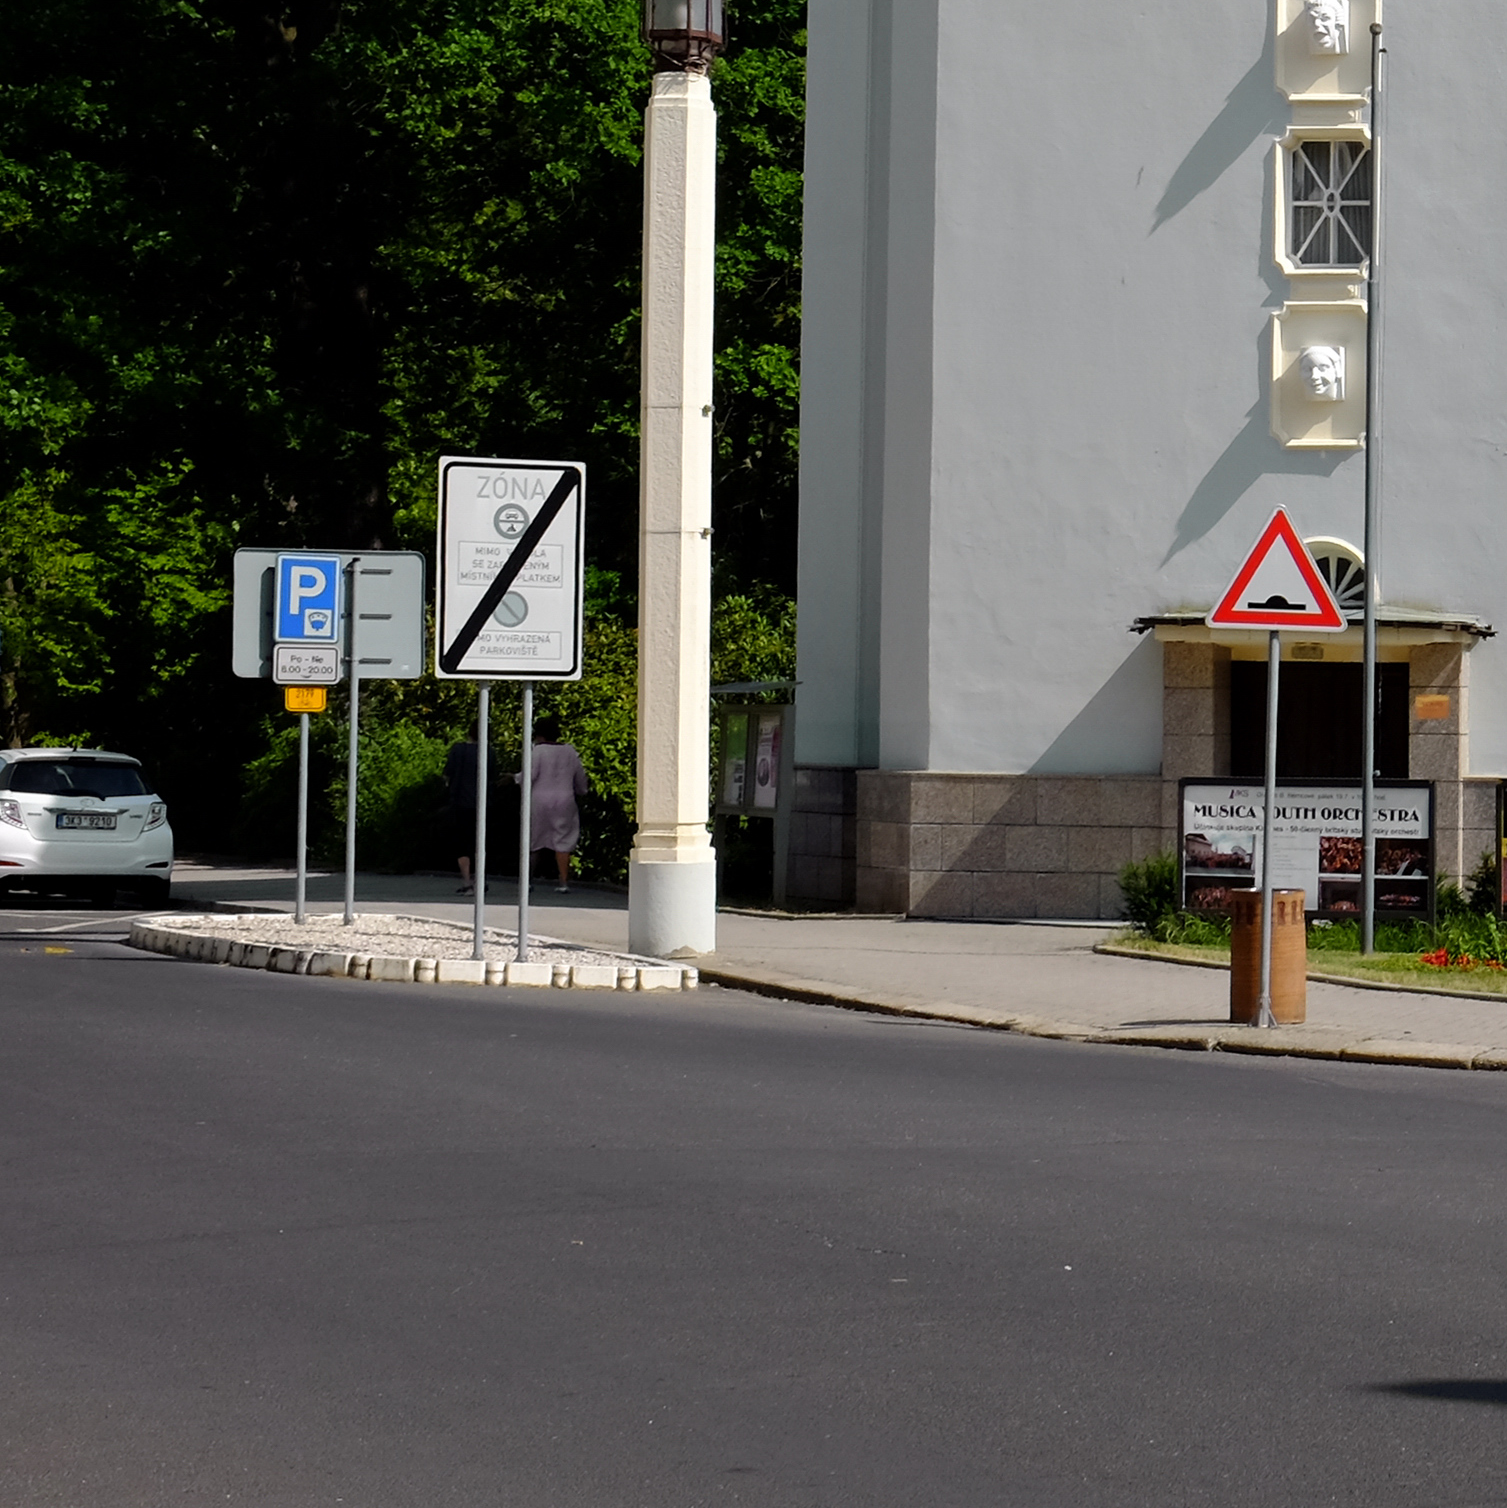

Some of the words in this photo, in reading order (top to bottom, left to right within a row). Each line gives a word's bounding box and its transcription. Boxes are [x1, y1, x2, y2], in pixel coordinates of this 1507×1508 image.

[477, 472, 546, 500] ZÓNA
[475, 547, 501, 556] MIMO
[472, 559, 484, 568] SE
[289, 565, 327, 615] P
[495, 632, 551, 644] VYHRAZENÁ
[480, 645, 538, 656] PARKOVIŠTĚ
[1193, 804, 1256, 819] MUSICA
